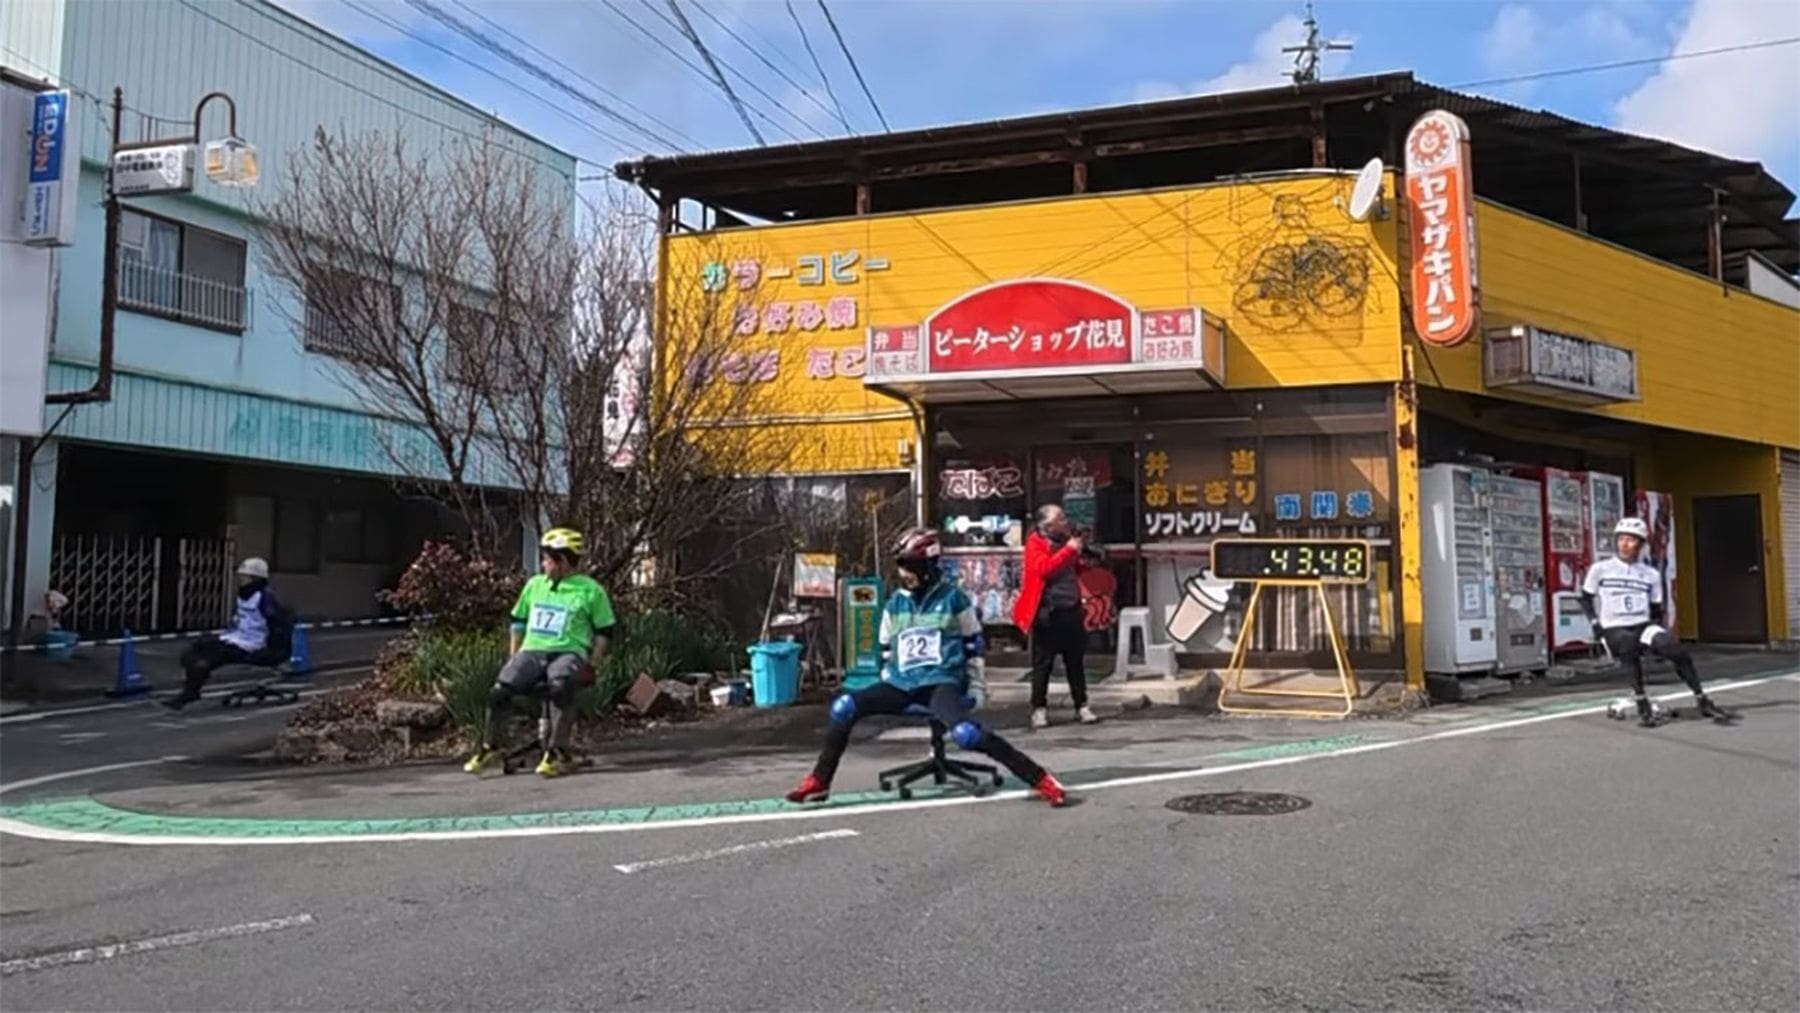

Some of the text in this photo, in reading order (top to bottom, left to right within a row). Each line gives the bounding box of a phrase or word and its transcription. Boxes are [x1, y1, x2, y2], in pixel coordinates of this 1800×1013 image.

[702, 251, 889, 292] カラーコピー
[940, 466, 1024, 500] たばこ
[1146, 480, 1256, 506] おにぎり
[1145, 511, 1257, 535] ソフトクリーム
[1624, 595, 1634, 612] 6
[536, 611, 555, 628] 17
[906, 637, 928, 657] 22
